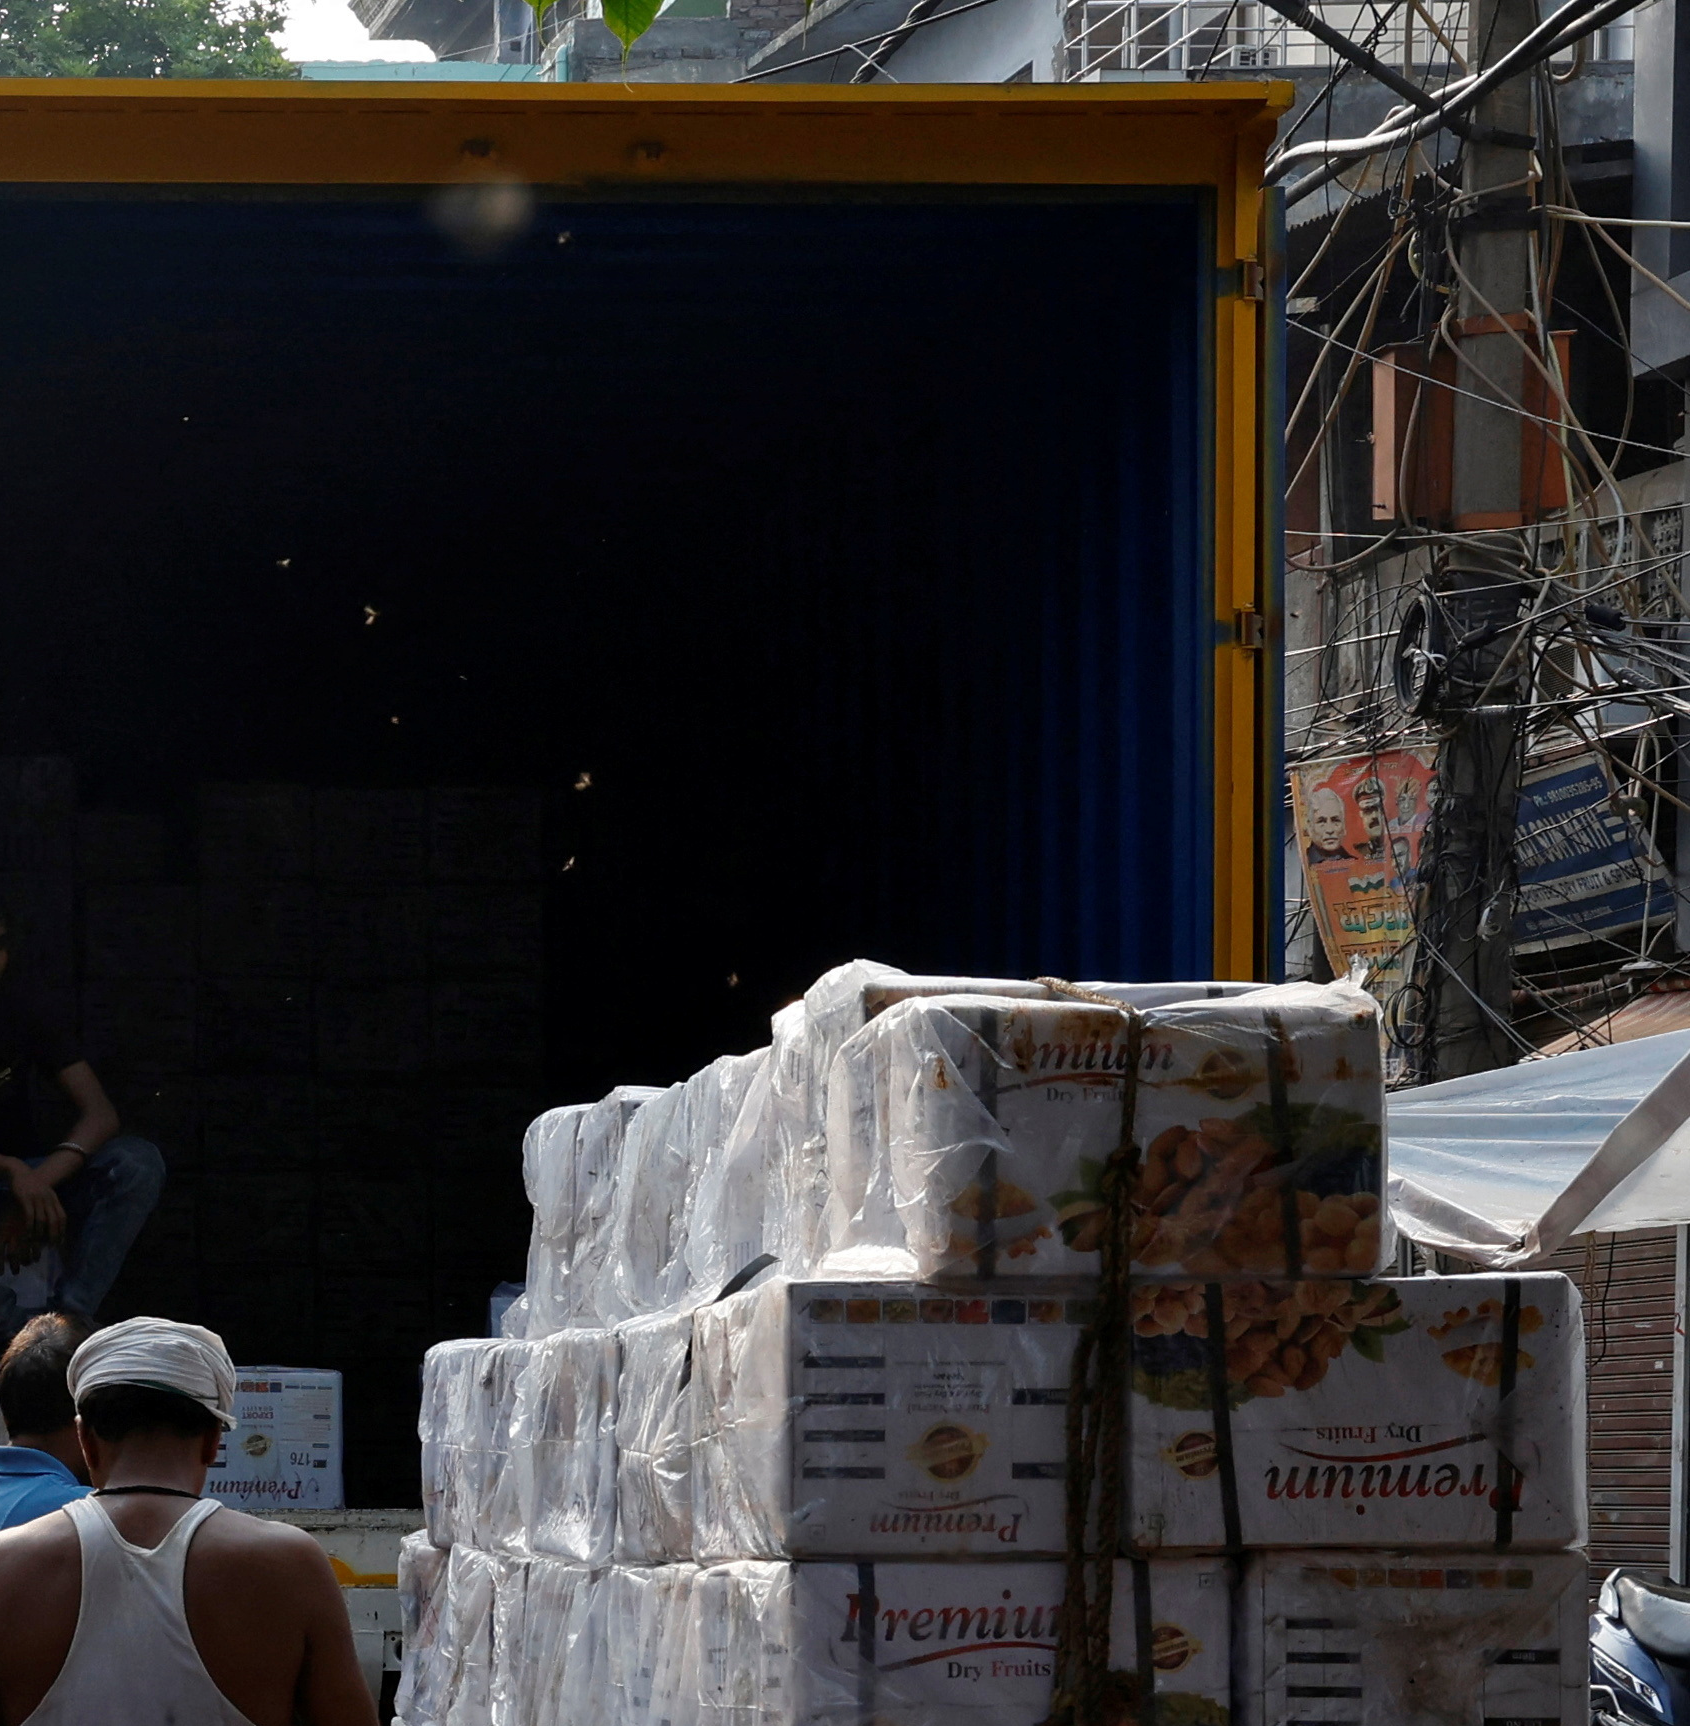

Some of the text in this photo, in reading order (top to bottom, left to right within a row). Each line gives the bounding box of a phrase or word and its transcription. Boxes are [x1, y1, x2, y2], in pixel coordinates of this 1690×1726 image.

[1046, 1087, 1075, 1104] Dry
[241, 1411, 274, 1420] EXPORT
[1316, 1424, 1422, 1444] Dry Fruits
[290, 1451, 310, 1466] 176
[209, 1479, 302, 1500] Premium
[1264, 1461, 1525, 1517] Premium
[870, 1512, 1022, 1544] Premium
[946, 1659, 1052, 1682] Dry Fruits
